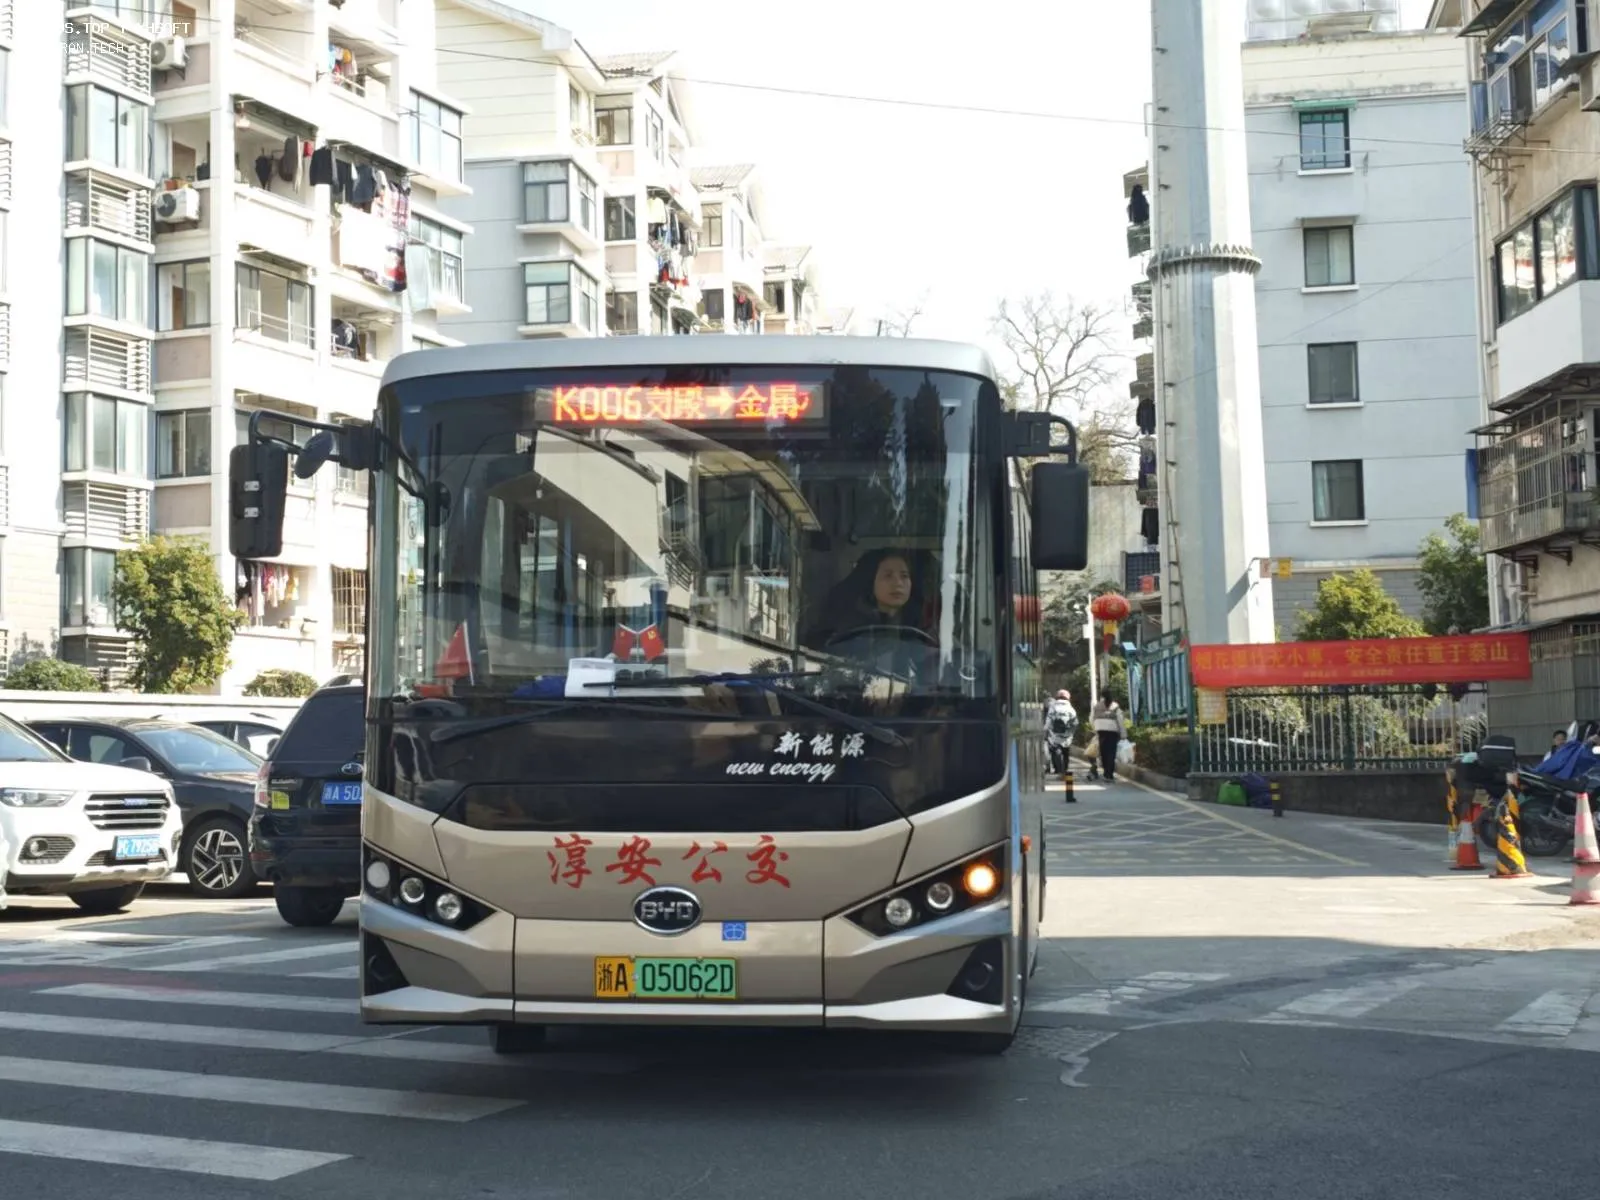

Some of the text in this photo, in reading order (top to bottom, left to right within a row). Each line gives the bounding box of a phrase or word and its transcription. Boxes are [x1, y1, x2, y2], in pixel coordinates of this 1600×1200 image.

[774, 731, 865, 758] 新能源
[726, 762, 836, 782] new energy
[547, 834, 791, 889] 淳安公交
[640, 901, 694, 920] BYD
